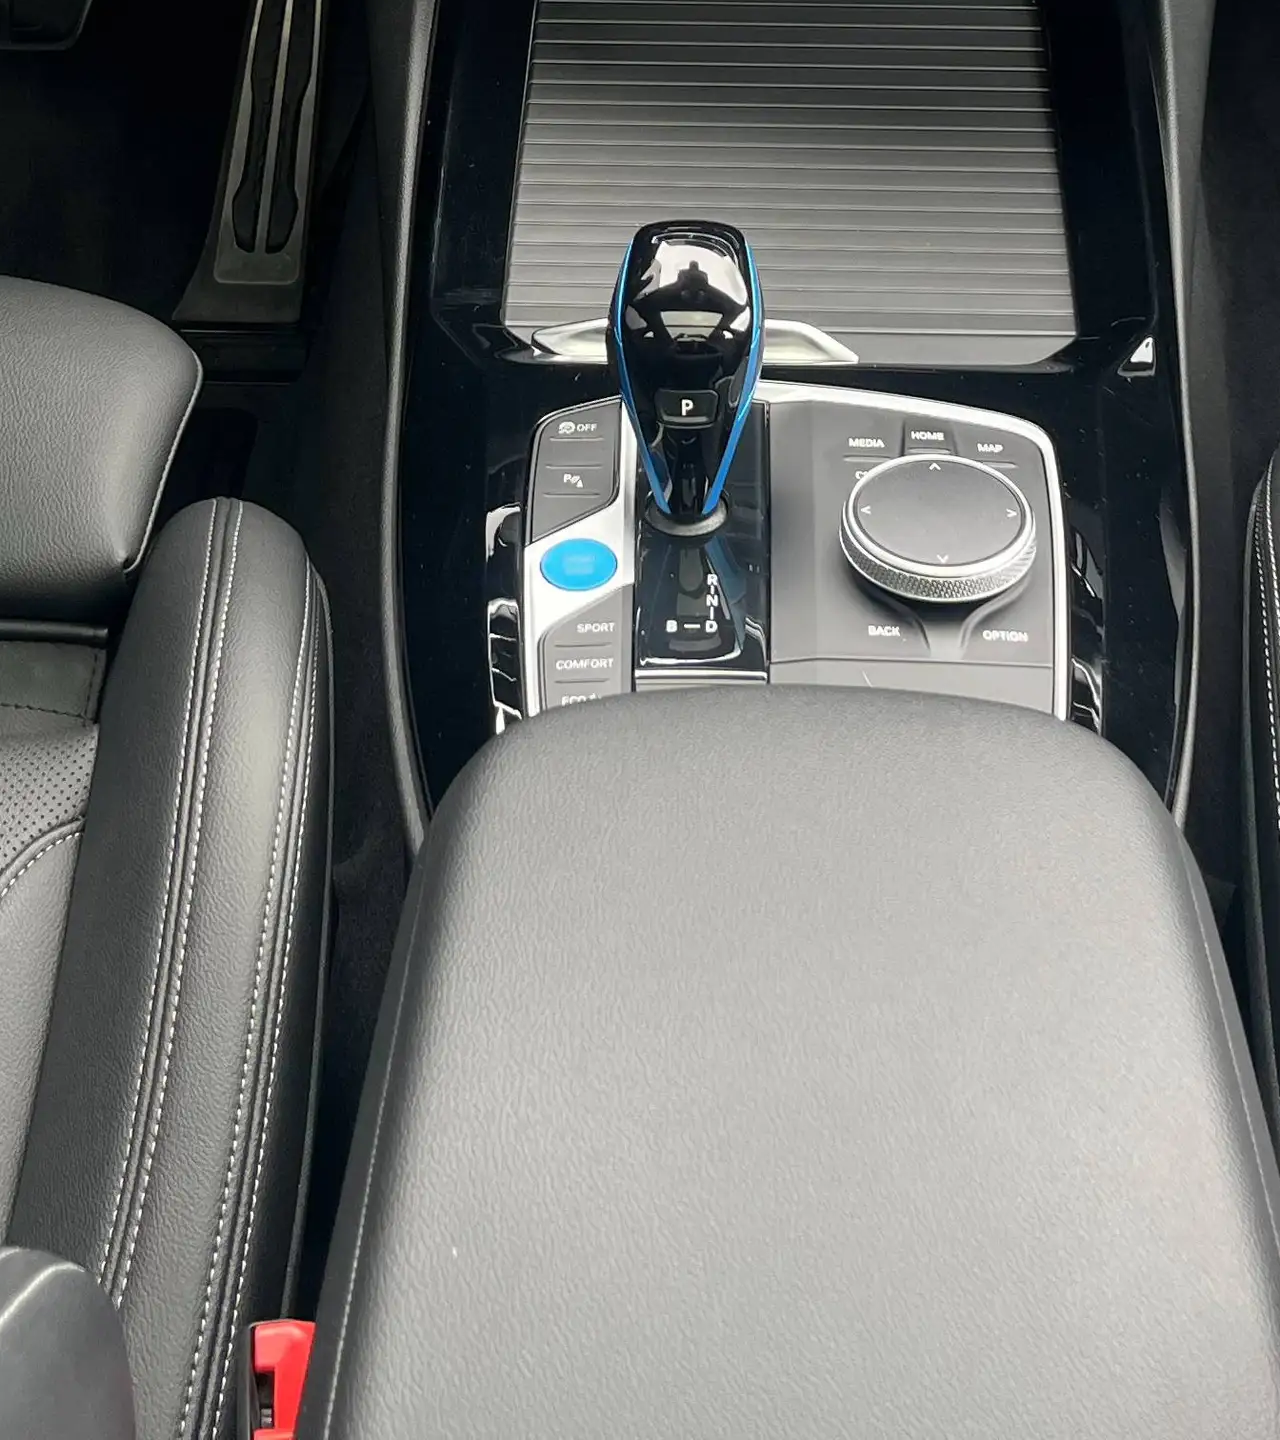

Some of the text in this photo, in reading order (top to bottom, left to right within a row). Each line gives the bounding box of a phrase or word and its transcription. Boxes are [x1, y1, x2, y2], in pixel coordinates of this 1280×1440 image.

[681, 398, 695, 417] P
[576, 422, 598, 432] OFF
[910, 430, 945, 442] HOME
[848, 437, 885, 449] MEDIA
[977, 443, 1004, 453] MAP
[706, 573, 718, 586] R
[706, 594, 719, 607] N
[576, 622, 616, 634] SPORT
[665, 620, 718, 633] B D
[867, 624, 901, 637] BACK
[982, 629, 1029, 643] OPTION
[555, 658, 615, 671] COMFORT
